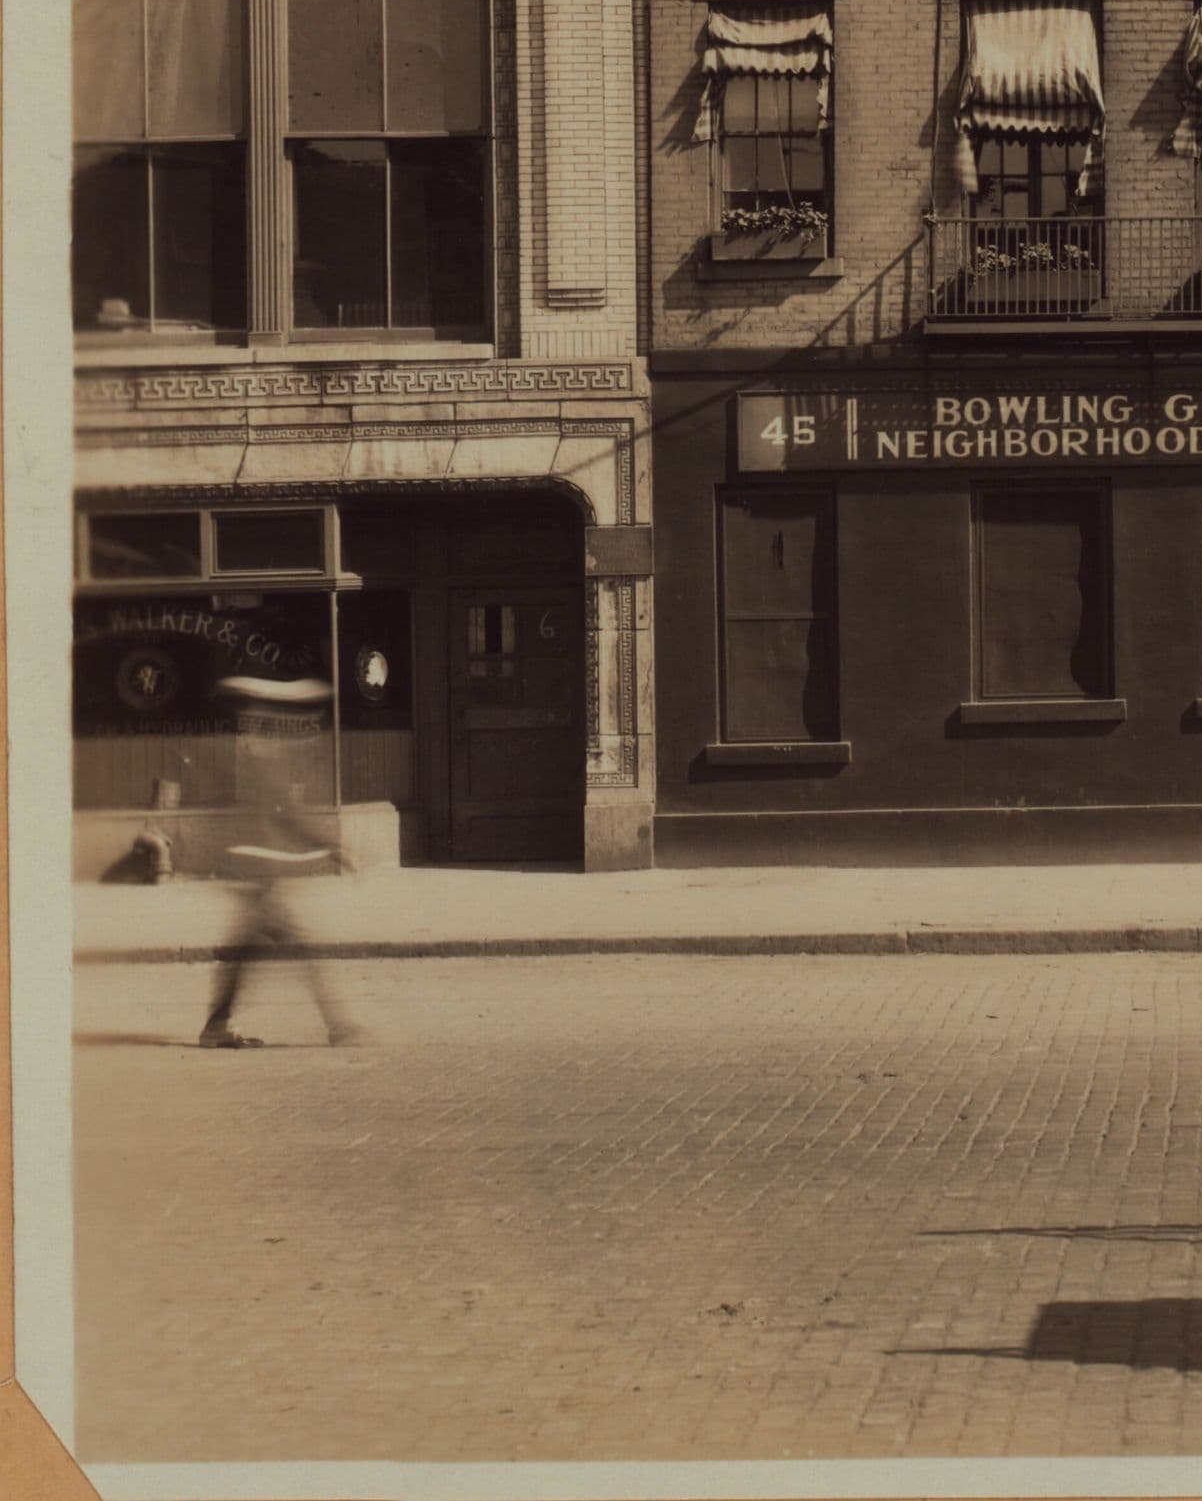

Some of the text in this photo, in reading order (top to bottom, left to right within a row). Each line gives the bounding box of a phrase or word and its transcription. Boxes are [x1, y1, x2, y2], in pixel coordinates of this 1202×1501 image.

[936, 395, 1133, 425] BOWLING
[761, 416, 815, 445] 45
[217, 620, 238, 647] &
